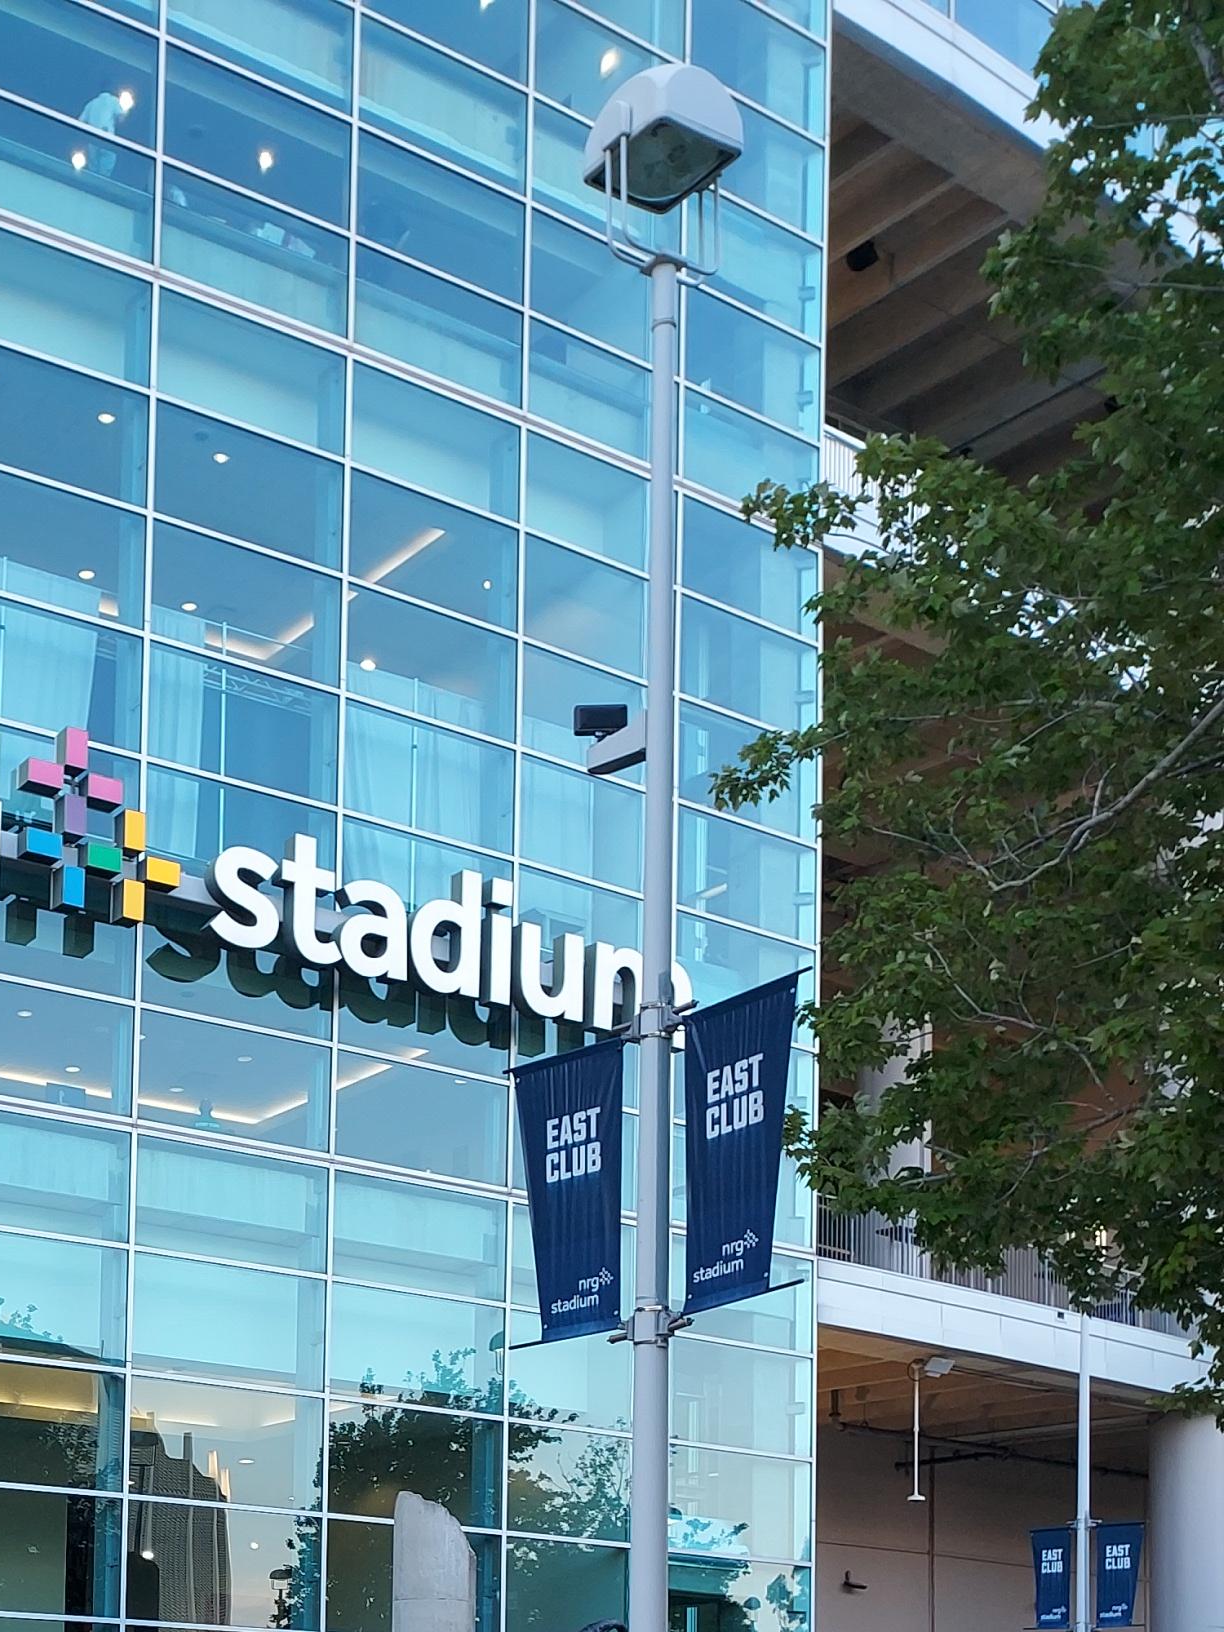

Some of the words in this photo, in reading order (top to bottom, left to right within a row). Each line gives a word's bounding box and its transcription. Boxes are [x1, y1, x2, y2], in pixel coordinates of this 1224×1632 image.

[707, 1052, 765, 1104] EAST
[706, 1090, 765, 1140] CLUB
[546, 1106, 602, 1150] EAST
[545, 1141, 603, 1184] CLUB
[722, 1238, 745, 1257] nrg
[692, 1257, 745, 1284] stadium
[578, 1275, 601, 1292] nrg
[550, 1292, 600, 1315] stadium
[1041, 1548, 1063, 1561] EAST
[1105, 1543, 1131, 1558] EAST
[1041, 1560, 1064, 1574] CLUB
[1105, 1556, 1131, 1571] CLUB
